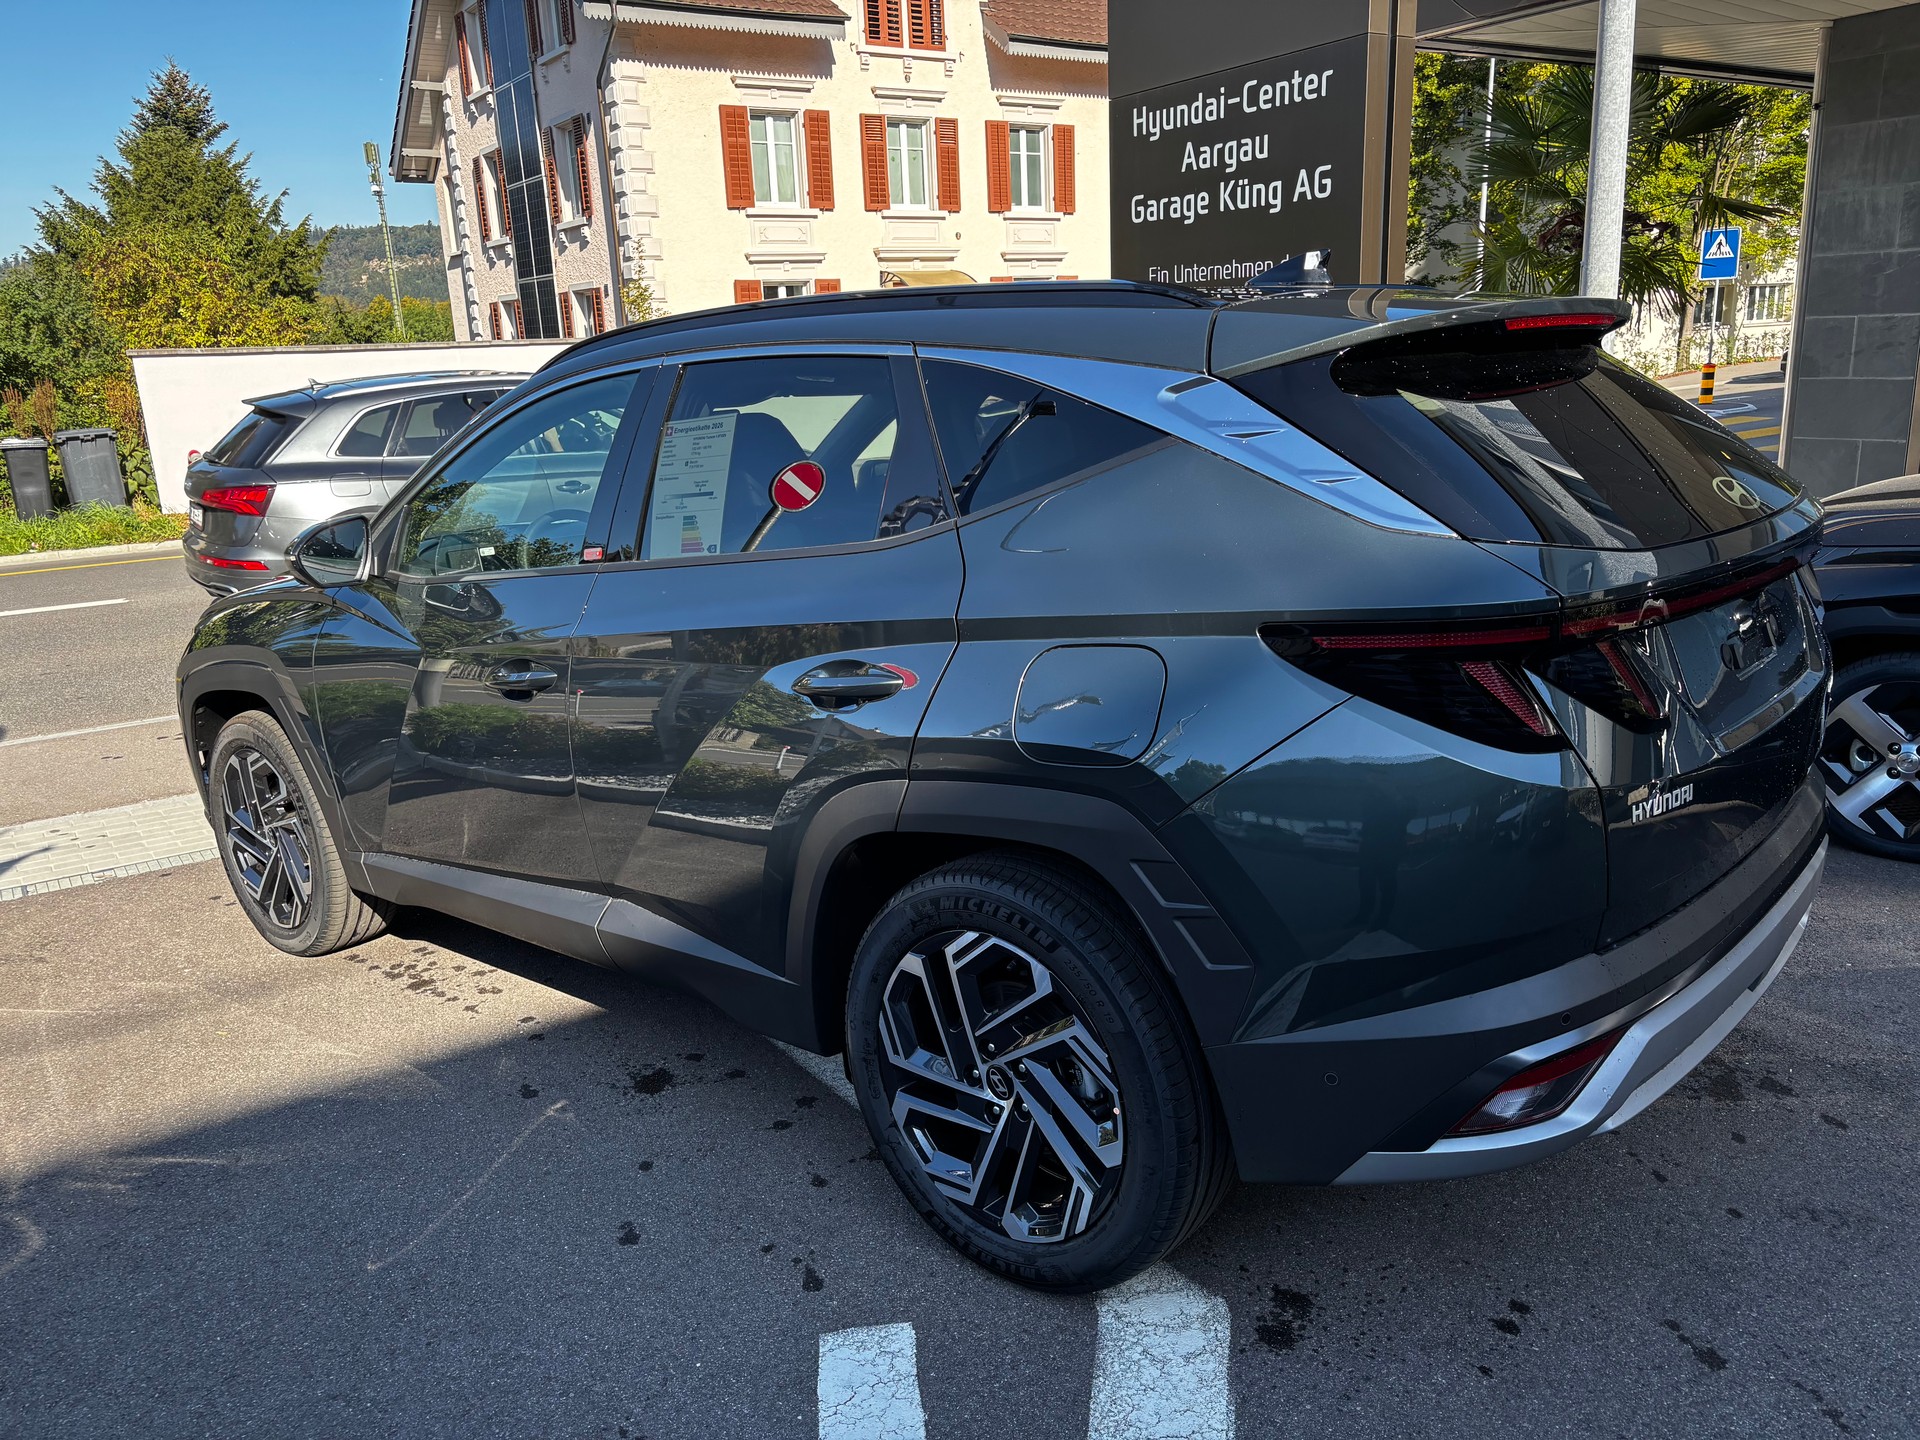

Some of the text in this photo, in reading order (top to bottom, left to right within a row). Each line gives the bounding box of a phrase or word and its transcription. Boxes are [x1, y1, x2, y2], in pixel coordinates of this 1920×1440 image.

[1132, 69, 1334, 142] Hyundai-Center
[1181, 134, 1269, 173] Aargau
[1131, 164, 1332, 224] Garage Küng AG
[1149, 266, 1169, 284] Ein
[1174, 258, 1274, 284] Unternehmen
[1632, 783, 1694, 824] HYUNDAI
[938, 896, 1054, 949] MICHELIN
[1063, 959, 1097, 997] 235/50
